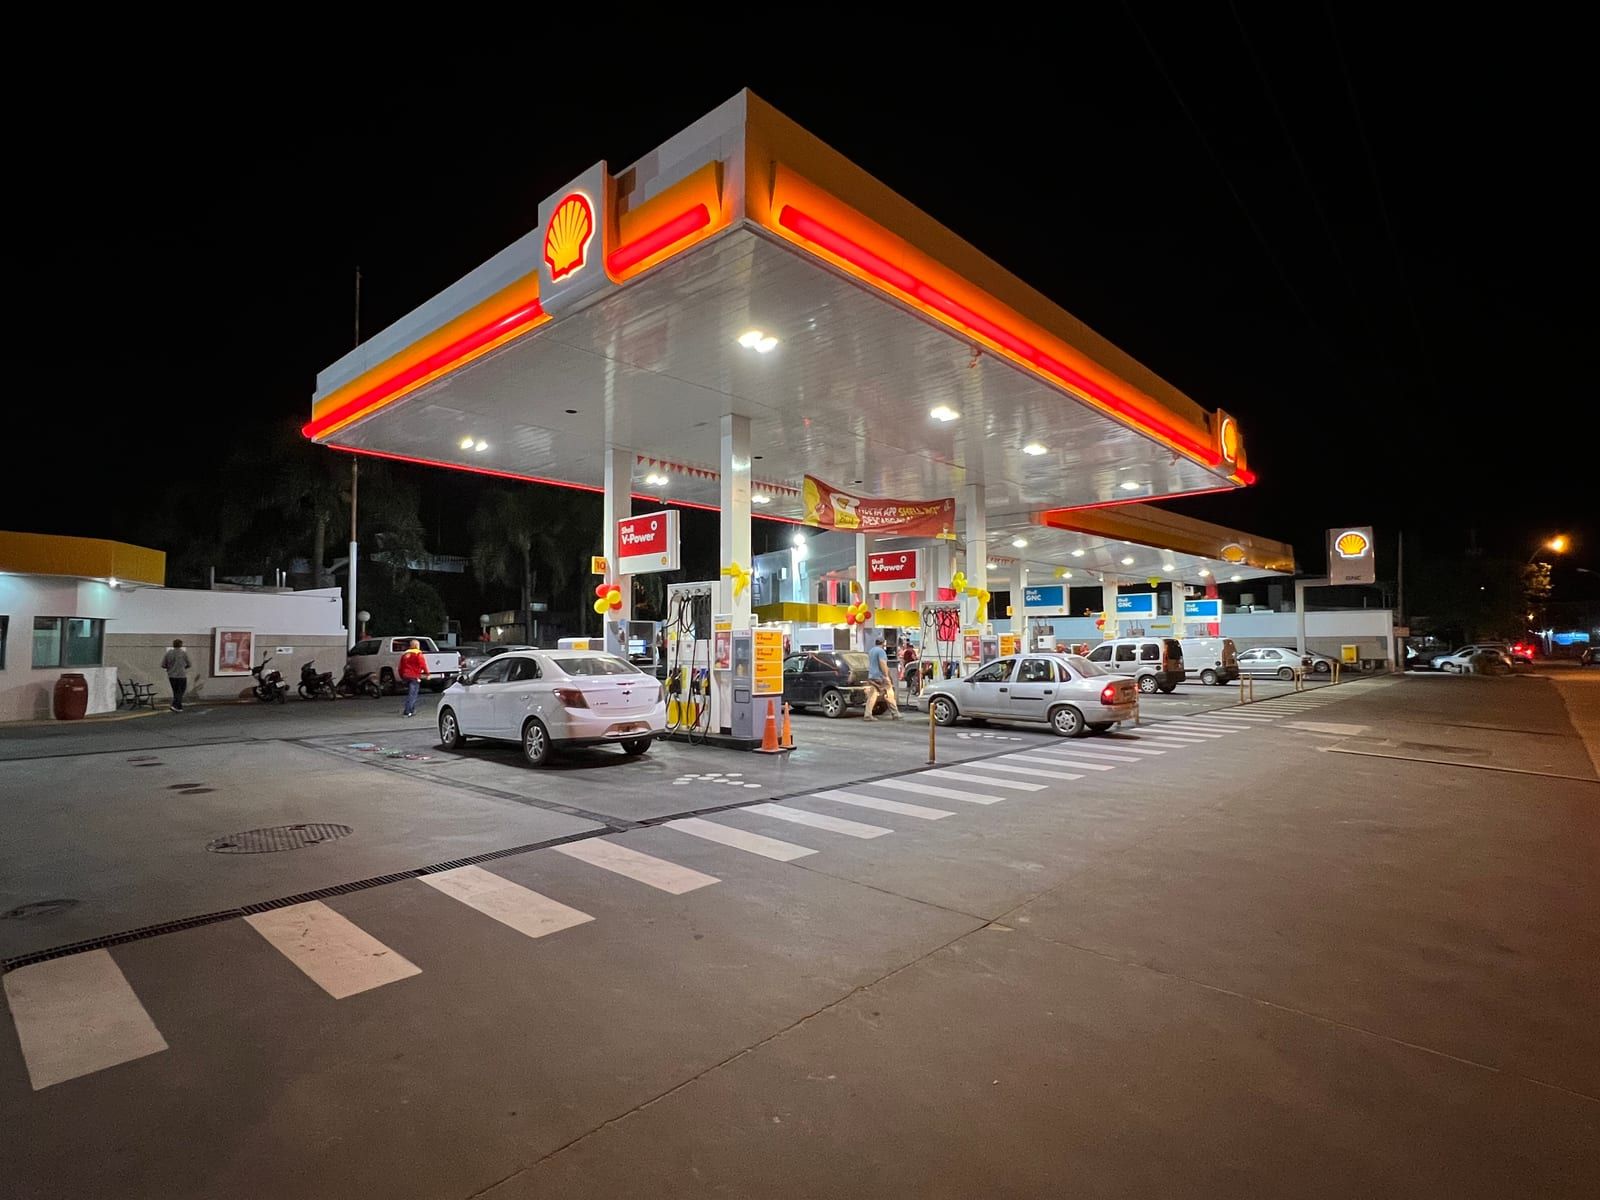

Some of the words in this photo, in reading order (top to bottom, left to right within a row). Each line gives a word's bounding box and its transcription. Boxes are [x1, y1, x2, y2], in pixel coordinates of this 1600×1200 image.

[621, 525, 635, 534] Shell
[621, 533, 655, 544] V-Power
[872, 564, 904, 572] V-Power
[1025, 594, 1042, 602] GNC
